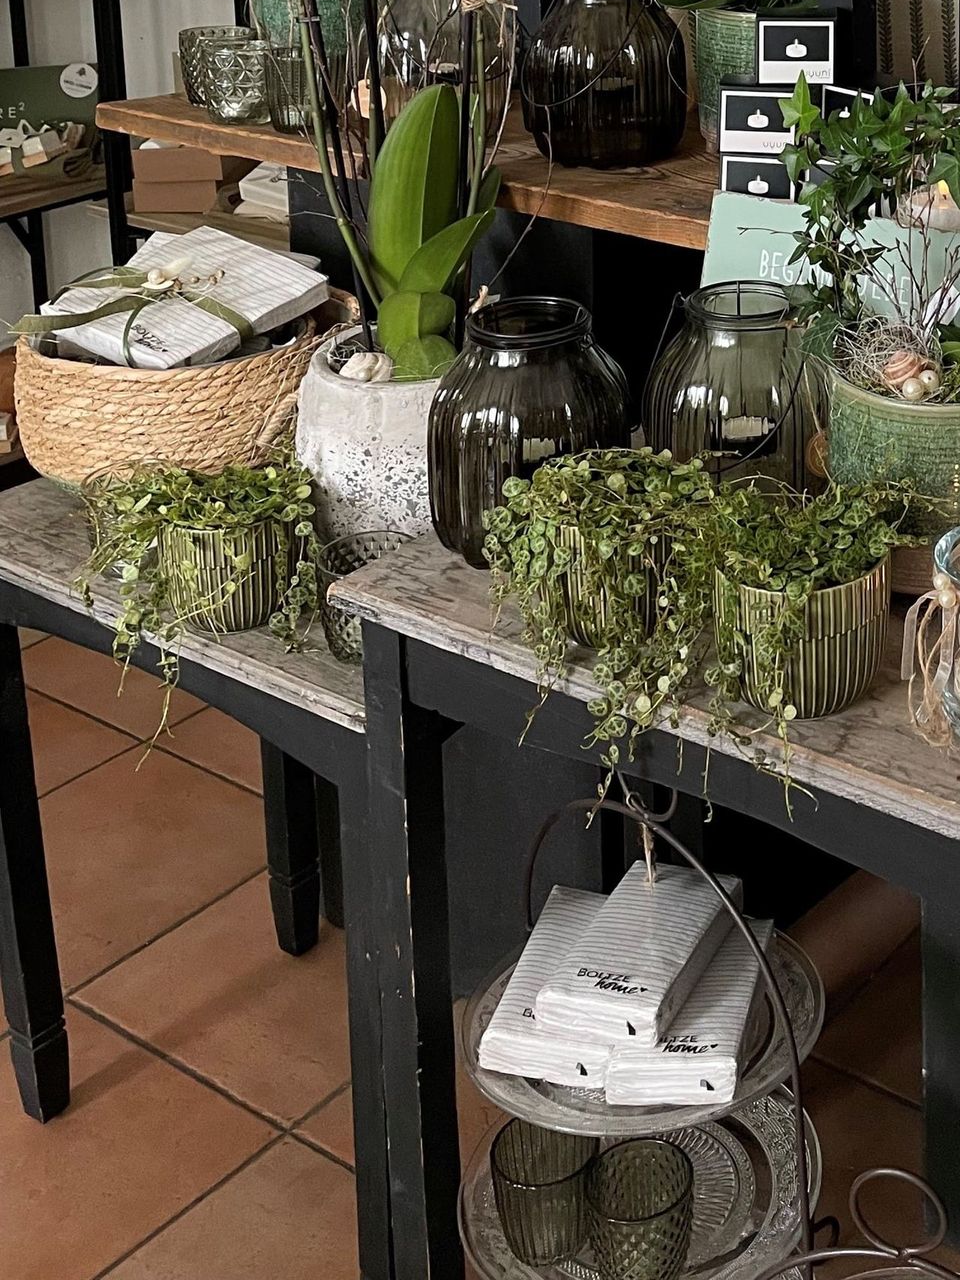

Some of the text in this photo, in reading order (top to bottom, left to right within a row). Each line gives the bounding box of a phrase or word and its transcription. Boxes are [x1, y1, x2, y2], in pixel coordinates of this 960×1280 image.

[577, 967, 631, 983] BOLTZE
[594, 976, 639, 995] home
[662, 1040, 710, 1054] home
